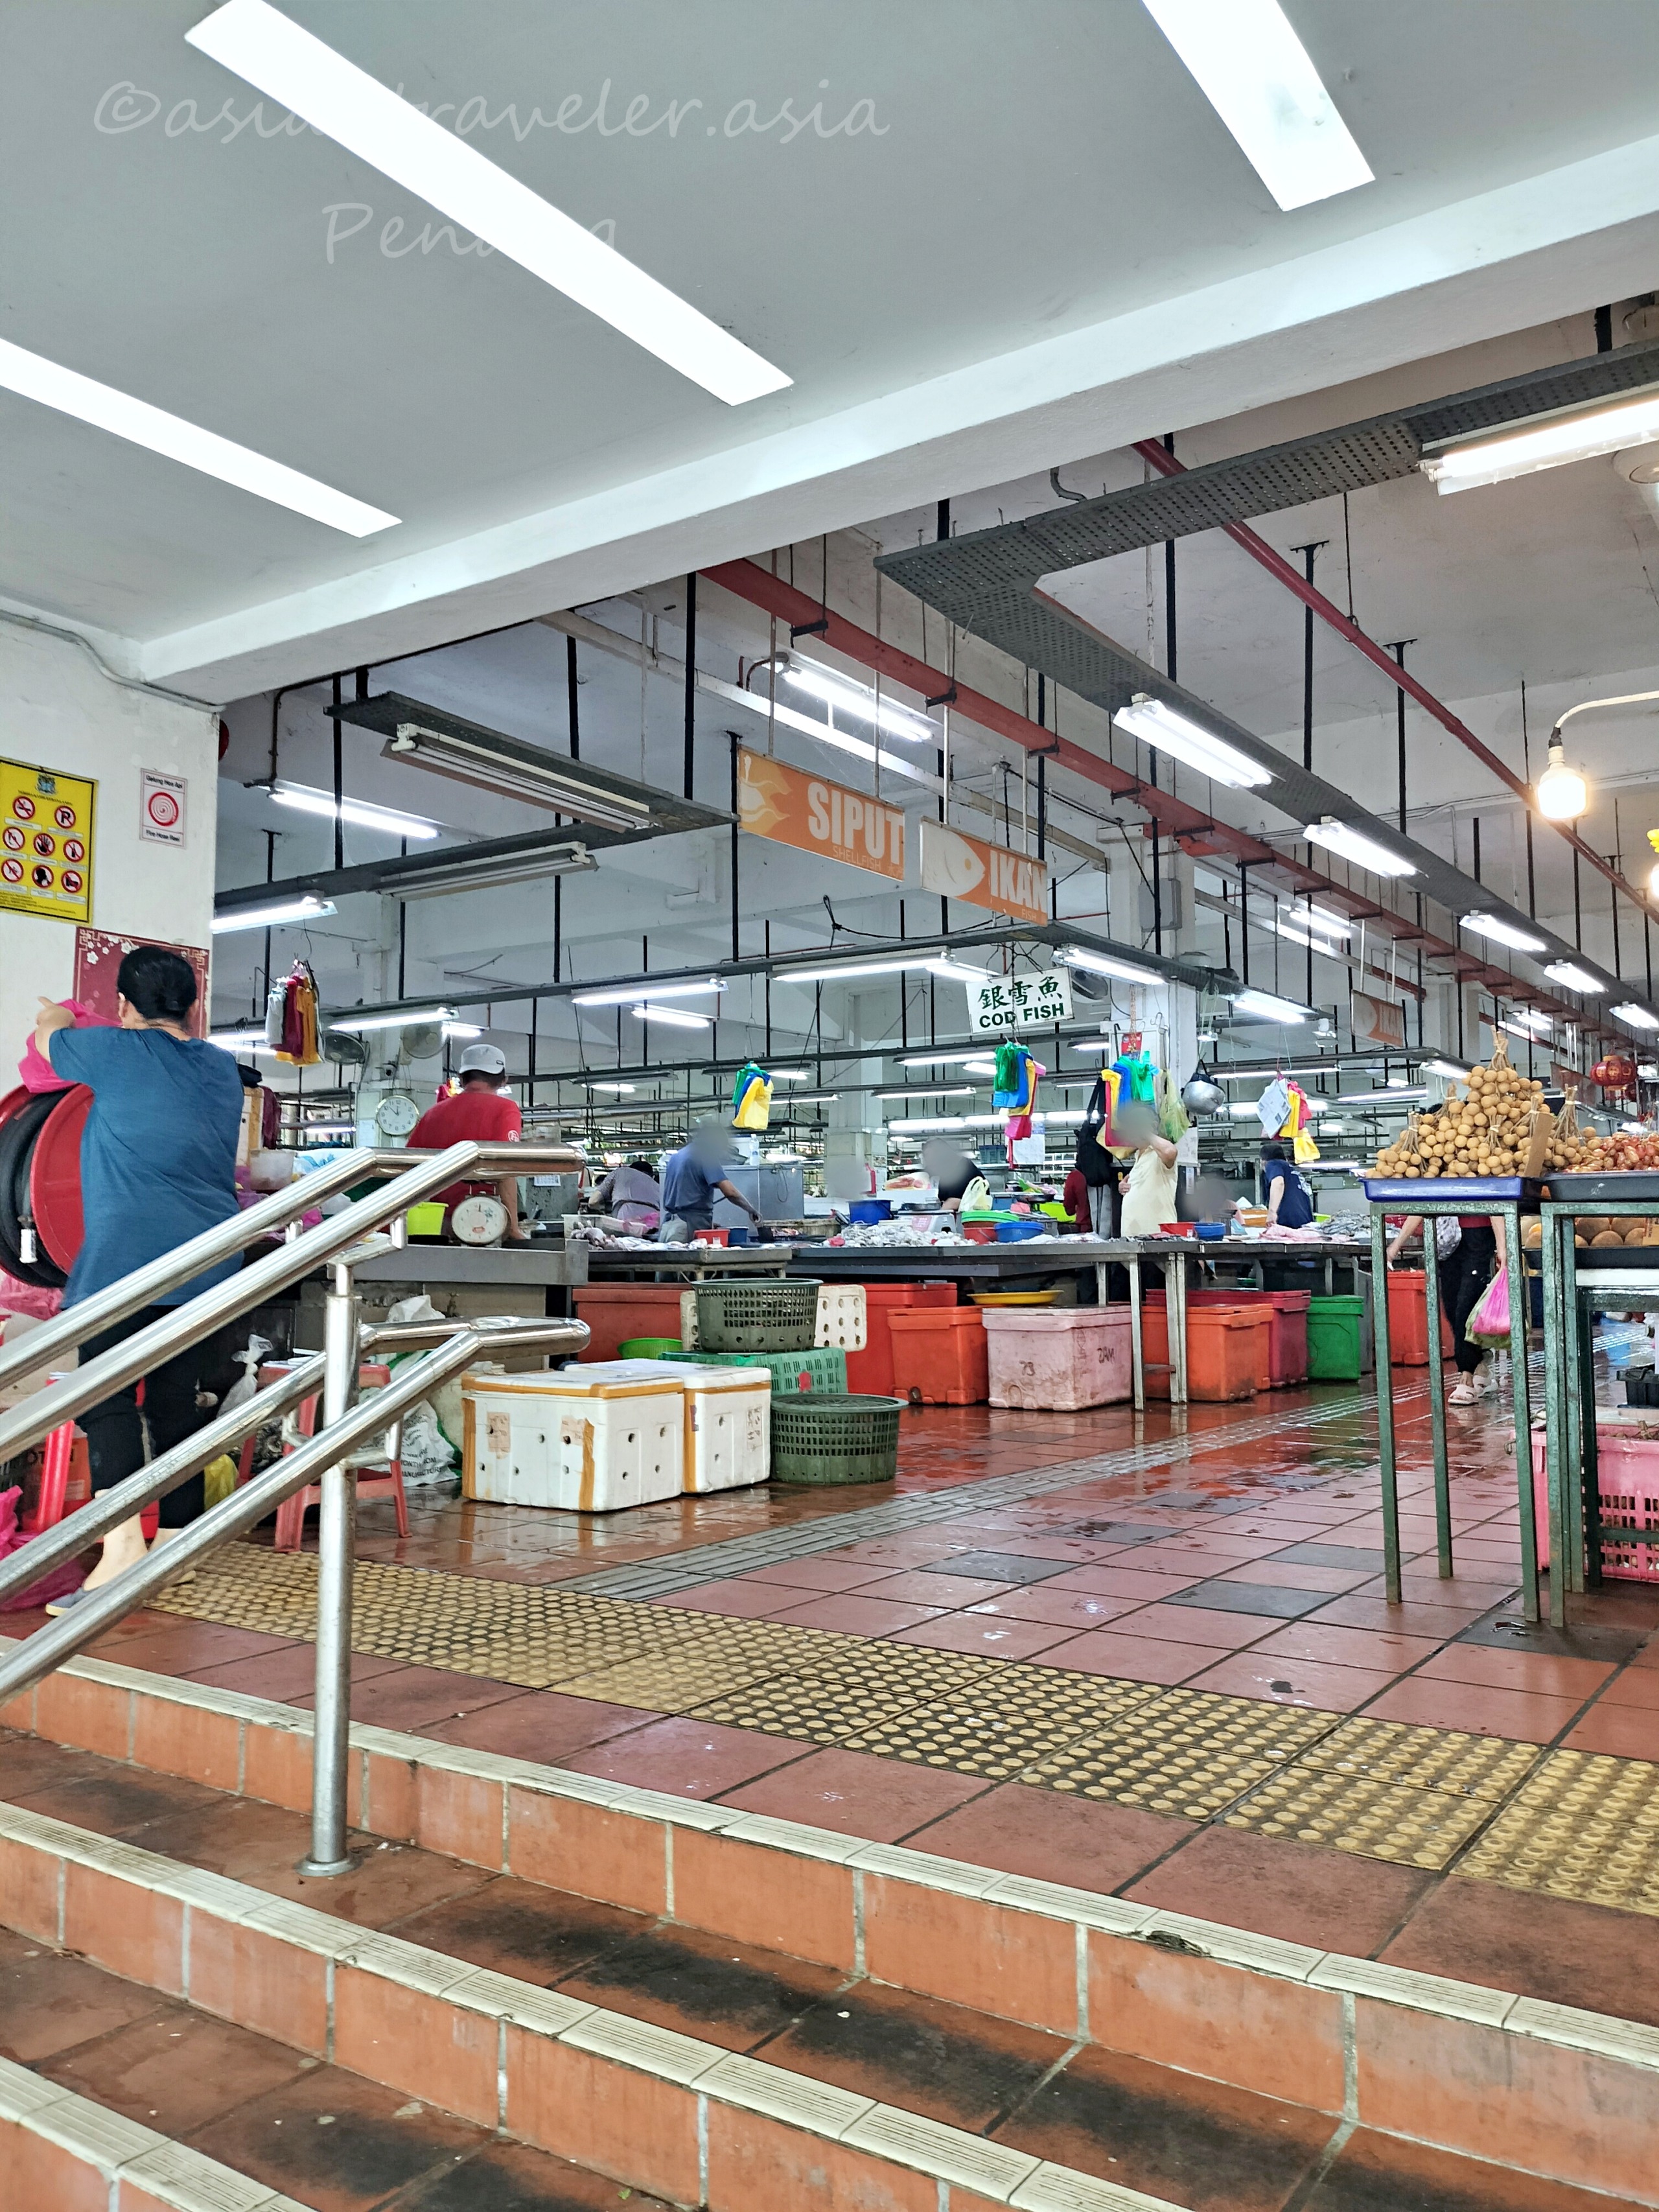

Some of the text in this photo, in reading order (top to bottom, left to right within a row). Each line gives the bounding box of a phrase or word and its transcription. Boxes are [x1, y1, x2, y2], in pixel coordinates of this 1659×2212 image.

[807, 782, 903, 865] SIPUT
[833, 845, 881, 871] SHELLFISH
[990, 850, 1047, 914] IKAN
[1022, 909, 1036, 920] FISH
[977, 976, 1063, 1010] 銀雪魚
[979, 1003, 1065, 1028] COD FISH
